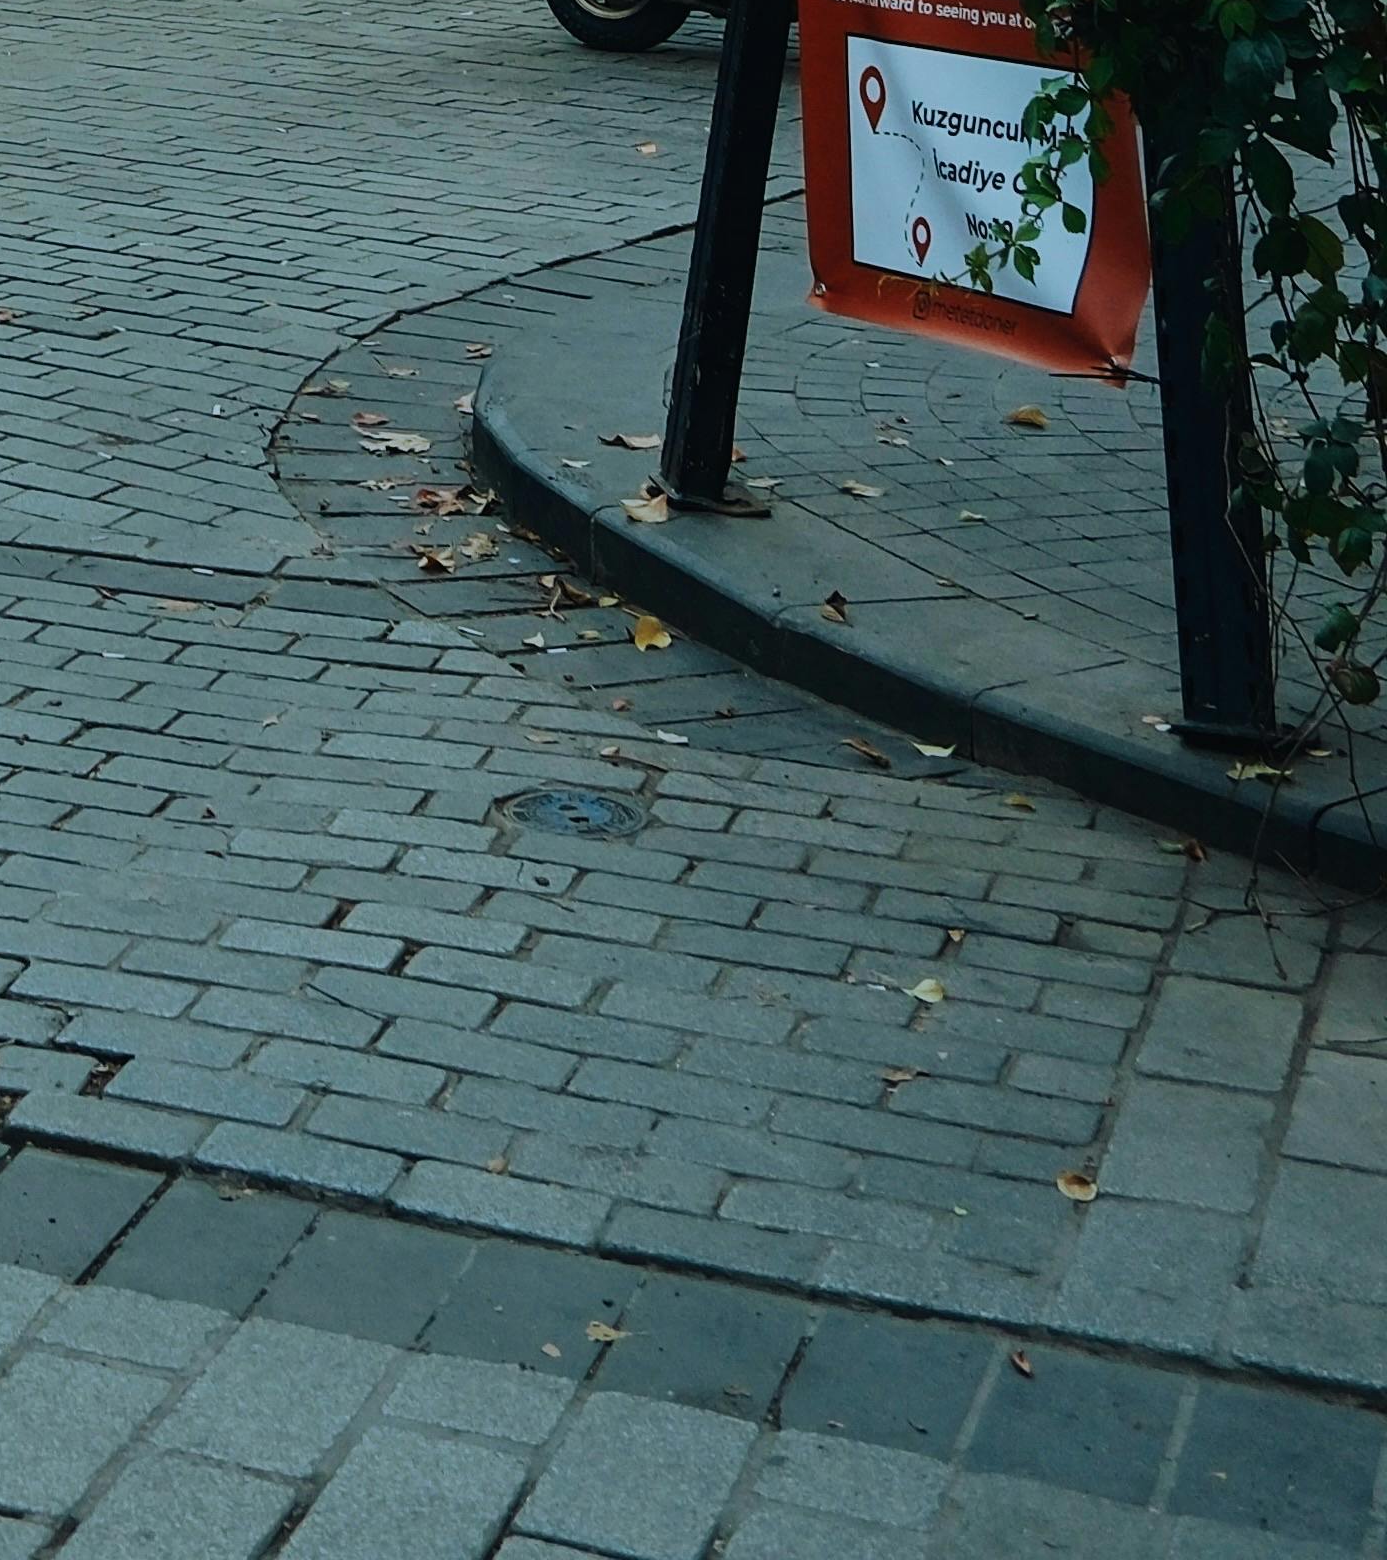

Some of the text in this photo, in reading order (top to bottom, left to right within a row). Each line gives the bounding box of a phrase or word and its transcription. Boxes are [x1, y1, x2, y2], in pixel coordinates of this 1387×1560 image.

[935, 1, 980, 26] seeing
[981, 8, 1008, 28] you
[1008, 11, 1022, 28] at
[933, 148, 1006, 193] İcadiye
